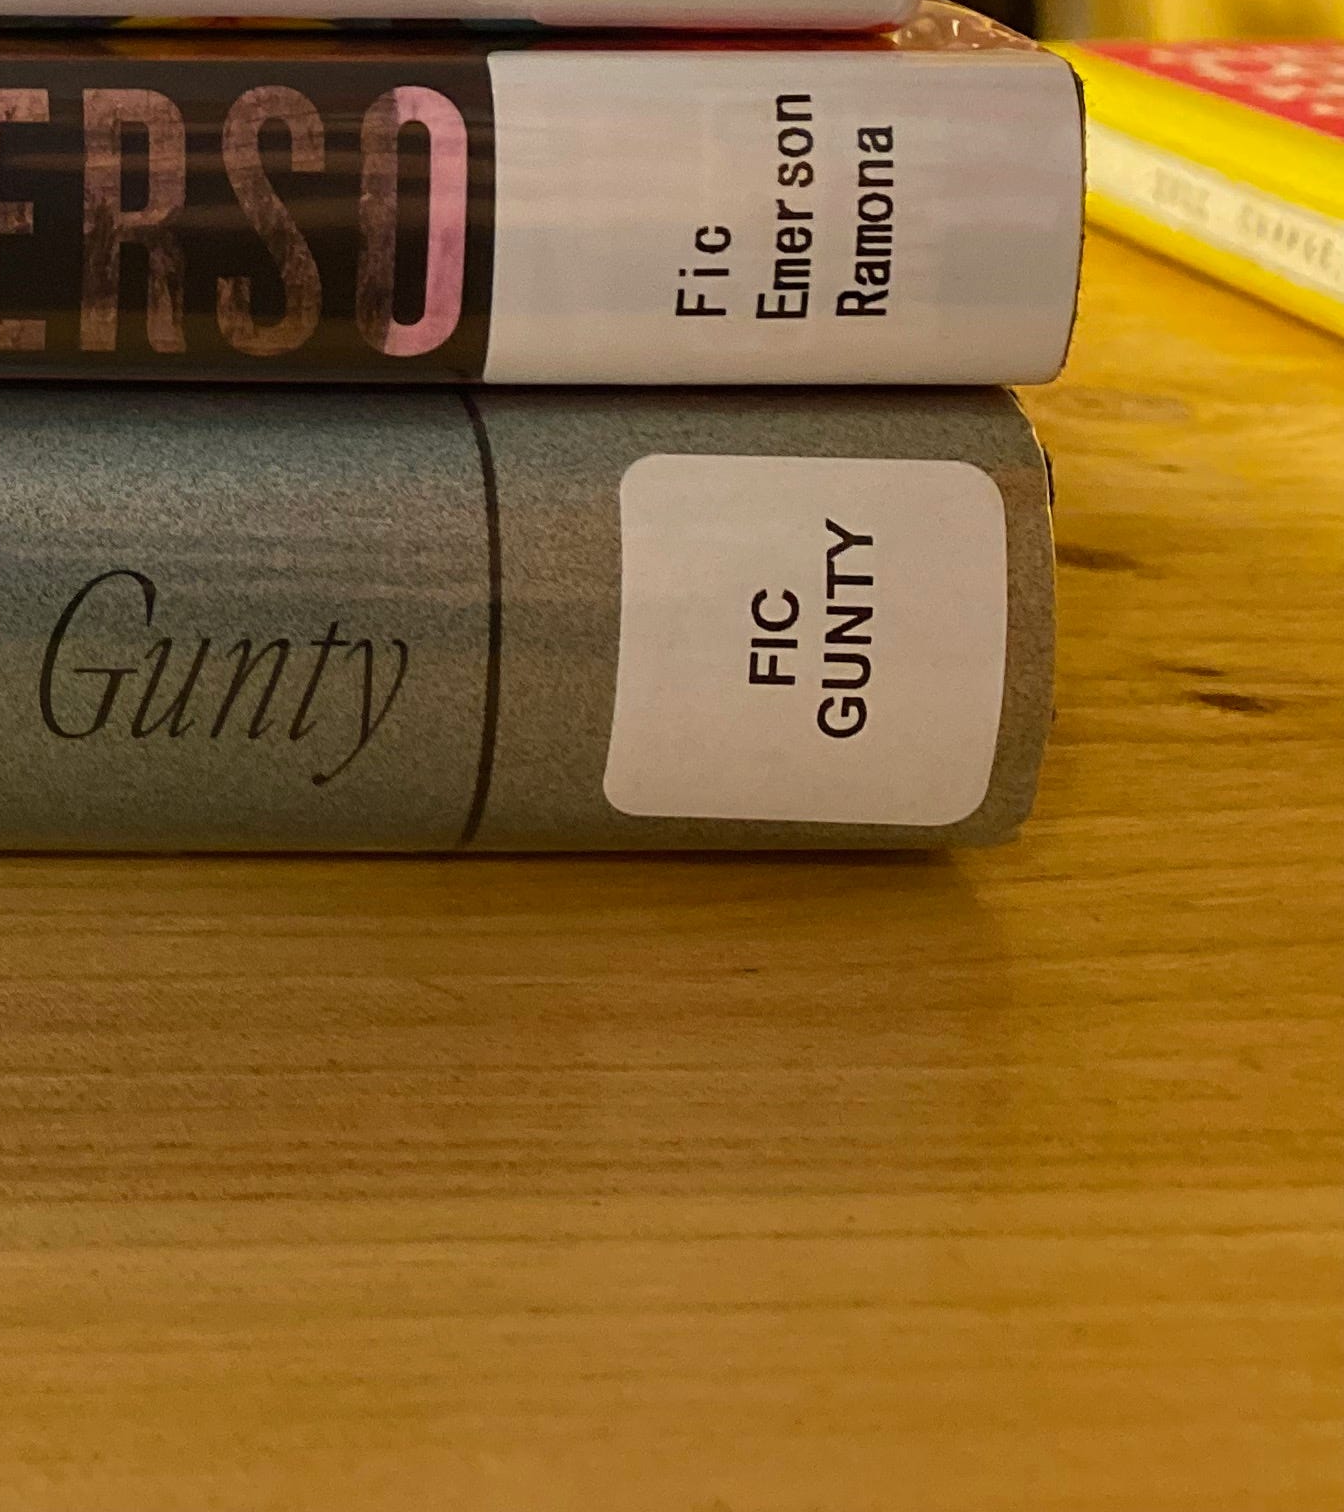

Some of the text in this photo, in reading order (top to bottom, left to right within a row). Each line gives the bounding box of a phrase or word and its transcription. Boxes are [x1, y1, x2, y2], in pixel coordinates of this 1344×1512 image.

[674, 224, 733, 317] Fic
[755, 93, 814, 319] Emerson
[834, 125, 895, 317] Ramona
[37, 568, 410, 787] Gunty
[748, 588, 801, 686] FIC
[816, 517, 875, 739] GUNTY
